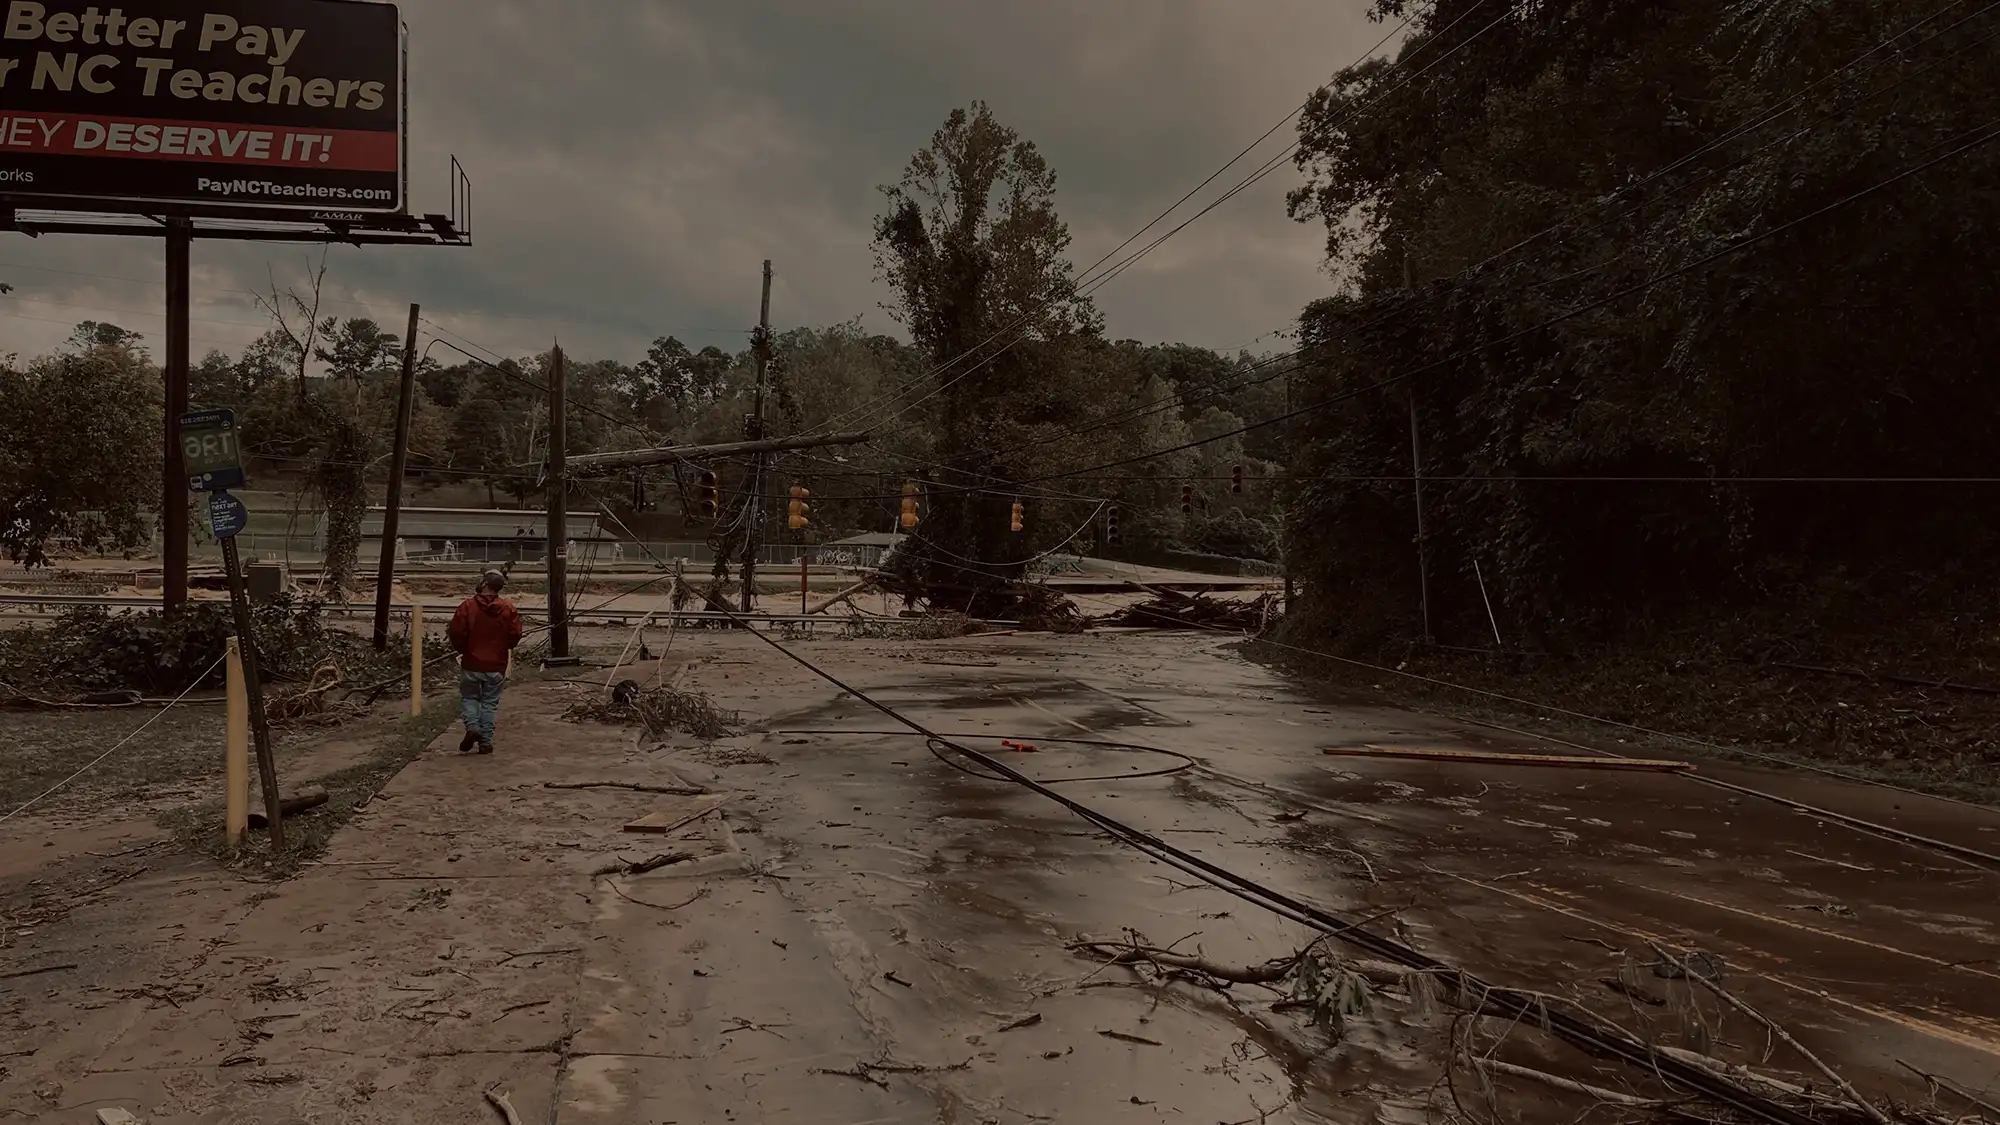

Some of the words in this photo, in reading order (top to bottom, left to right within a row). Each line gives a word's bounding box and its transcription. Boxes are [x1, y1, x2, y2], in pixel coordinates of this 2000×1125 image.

[4, 0, 187, 49] Better
[198, 12, 306, 66] Pay
[31, 51, 121, 94] NC
[135, 50, 387, 111] Teachers
[73, 120, 275, 160] DESERVE
[280, 132, 334, 163] IT!
[0, 167, 34, 183] orks
[197, 177, 393, 201] PayNCTeachers.com
[313, 210, 366, 222] LAMAR
